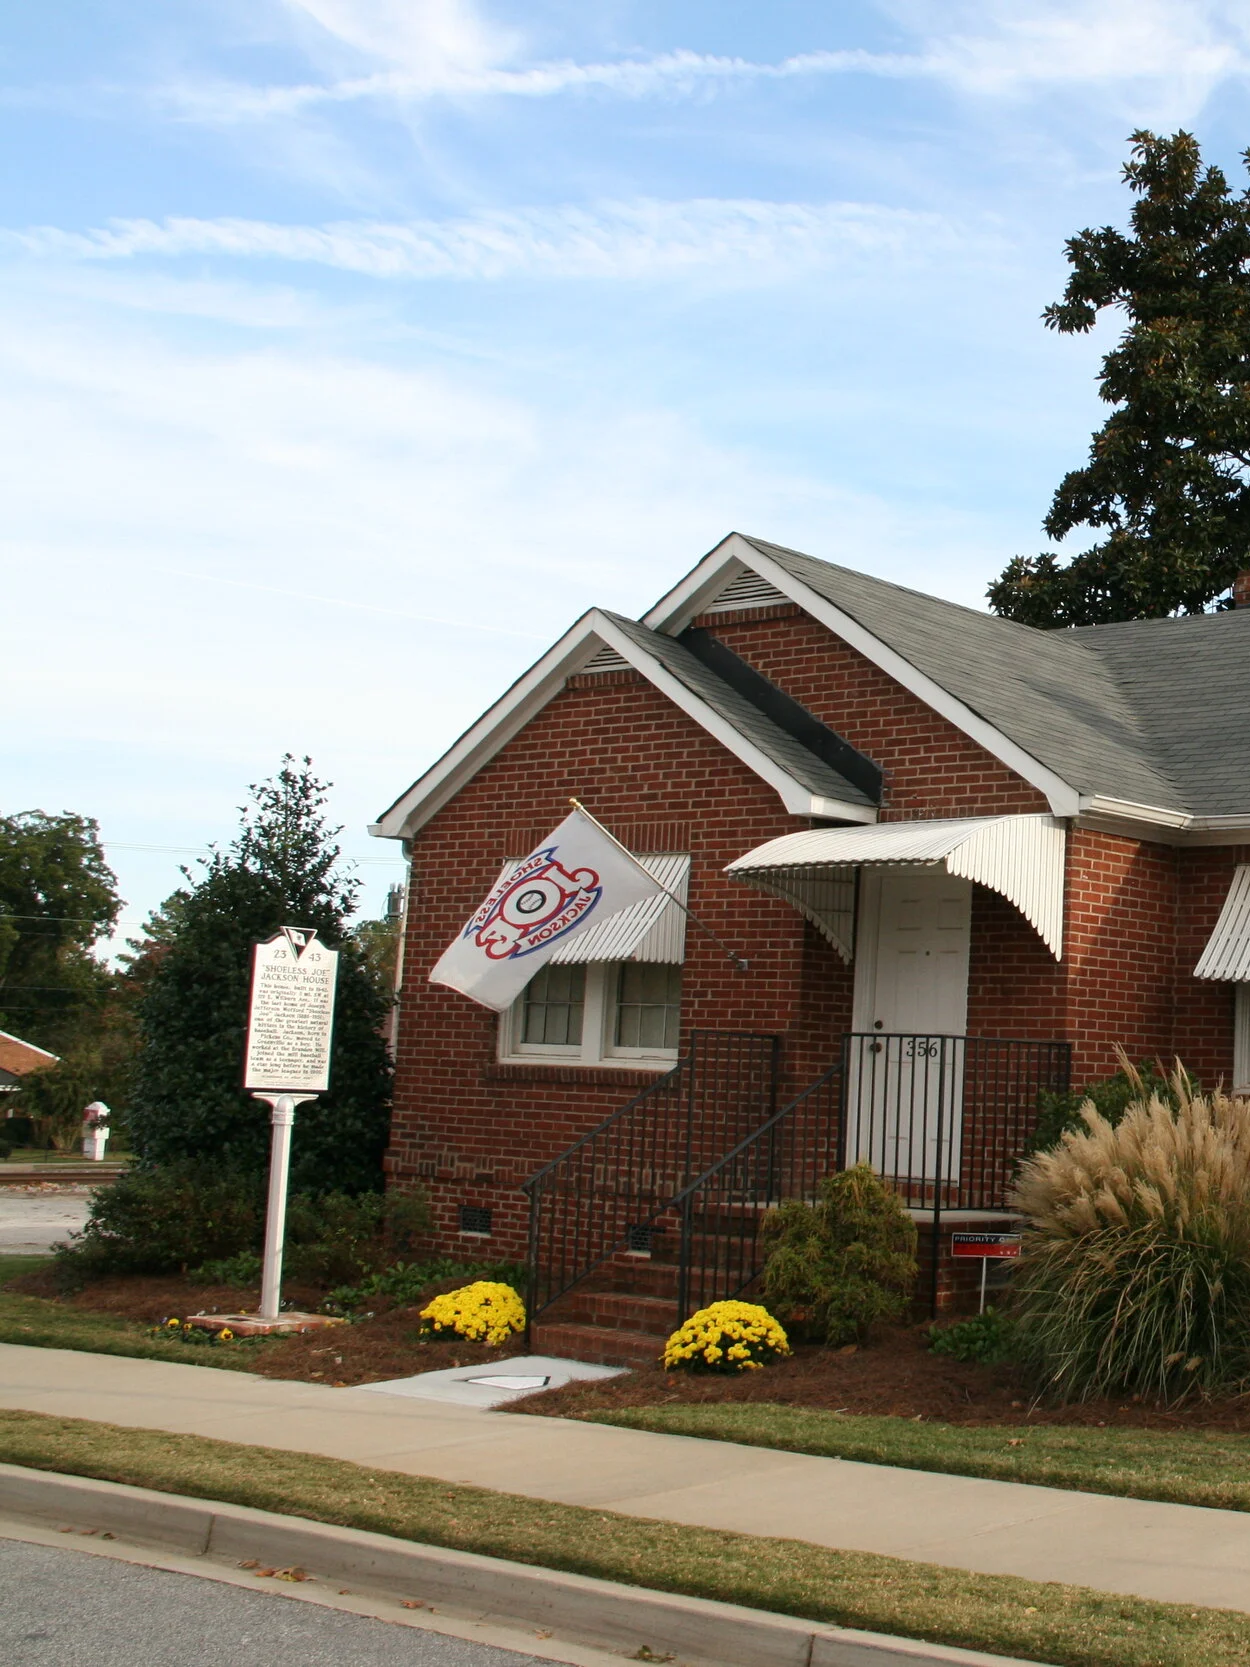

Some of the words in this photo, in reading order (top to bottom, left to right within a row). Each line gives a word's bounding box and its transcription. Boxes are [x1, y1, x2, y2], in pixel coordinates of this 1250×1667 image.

[274, 949, 287, 959] 23
[308, 953, 321, 962] 43
[262, 964, 307, 976] "SHOELESS
[260, 973, 299, 983] JACKSON
[303, 975, 330, 985] HOUSE
[906, 1041, 938, 1058] 356
[955, 1235, 996, 1243] PRIORITY
